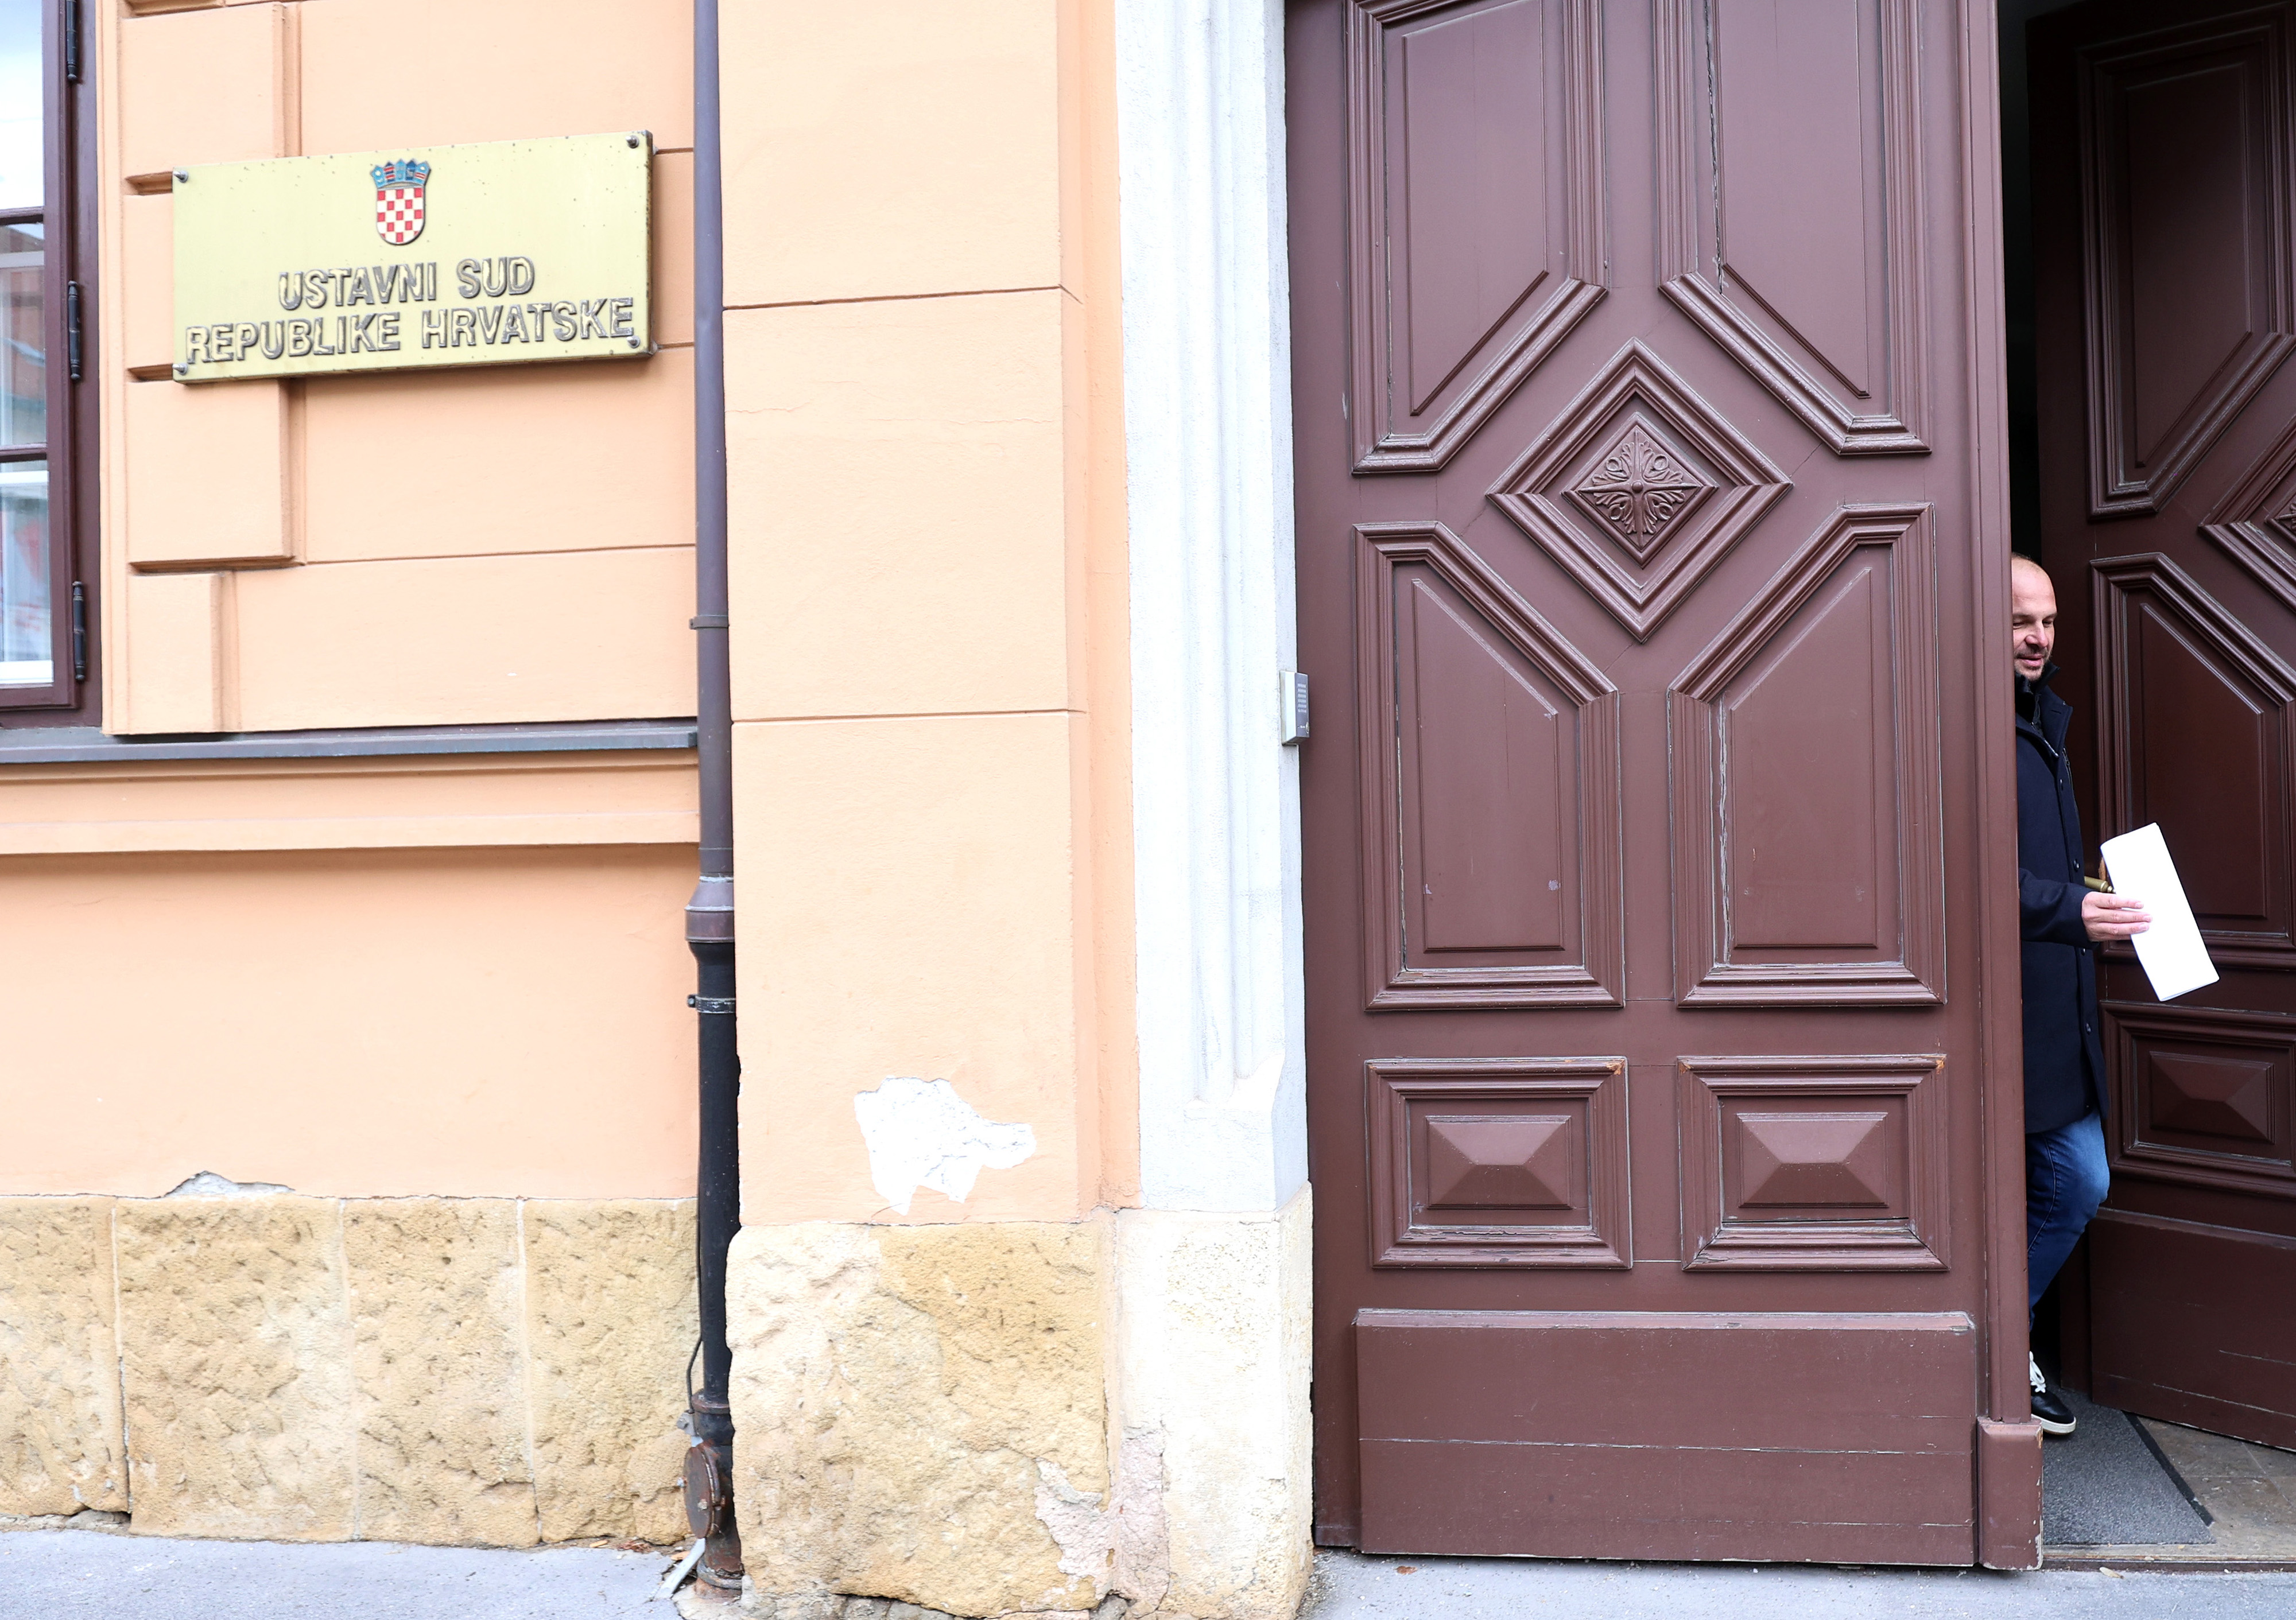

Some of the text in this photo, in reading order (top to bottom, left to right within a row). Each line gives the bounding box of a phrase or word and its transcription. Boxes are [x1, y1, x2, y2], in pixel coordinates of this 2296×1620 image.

[278, 256, 534, 310] USTAVNI SUD
[185, 297, 634, 364] REPUBLIKE HRVATSKE
